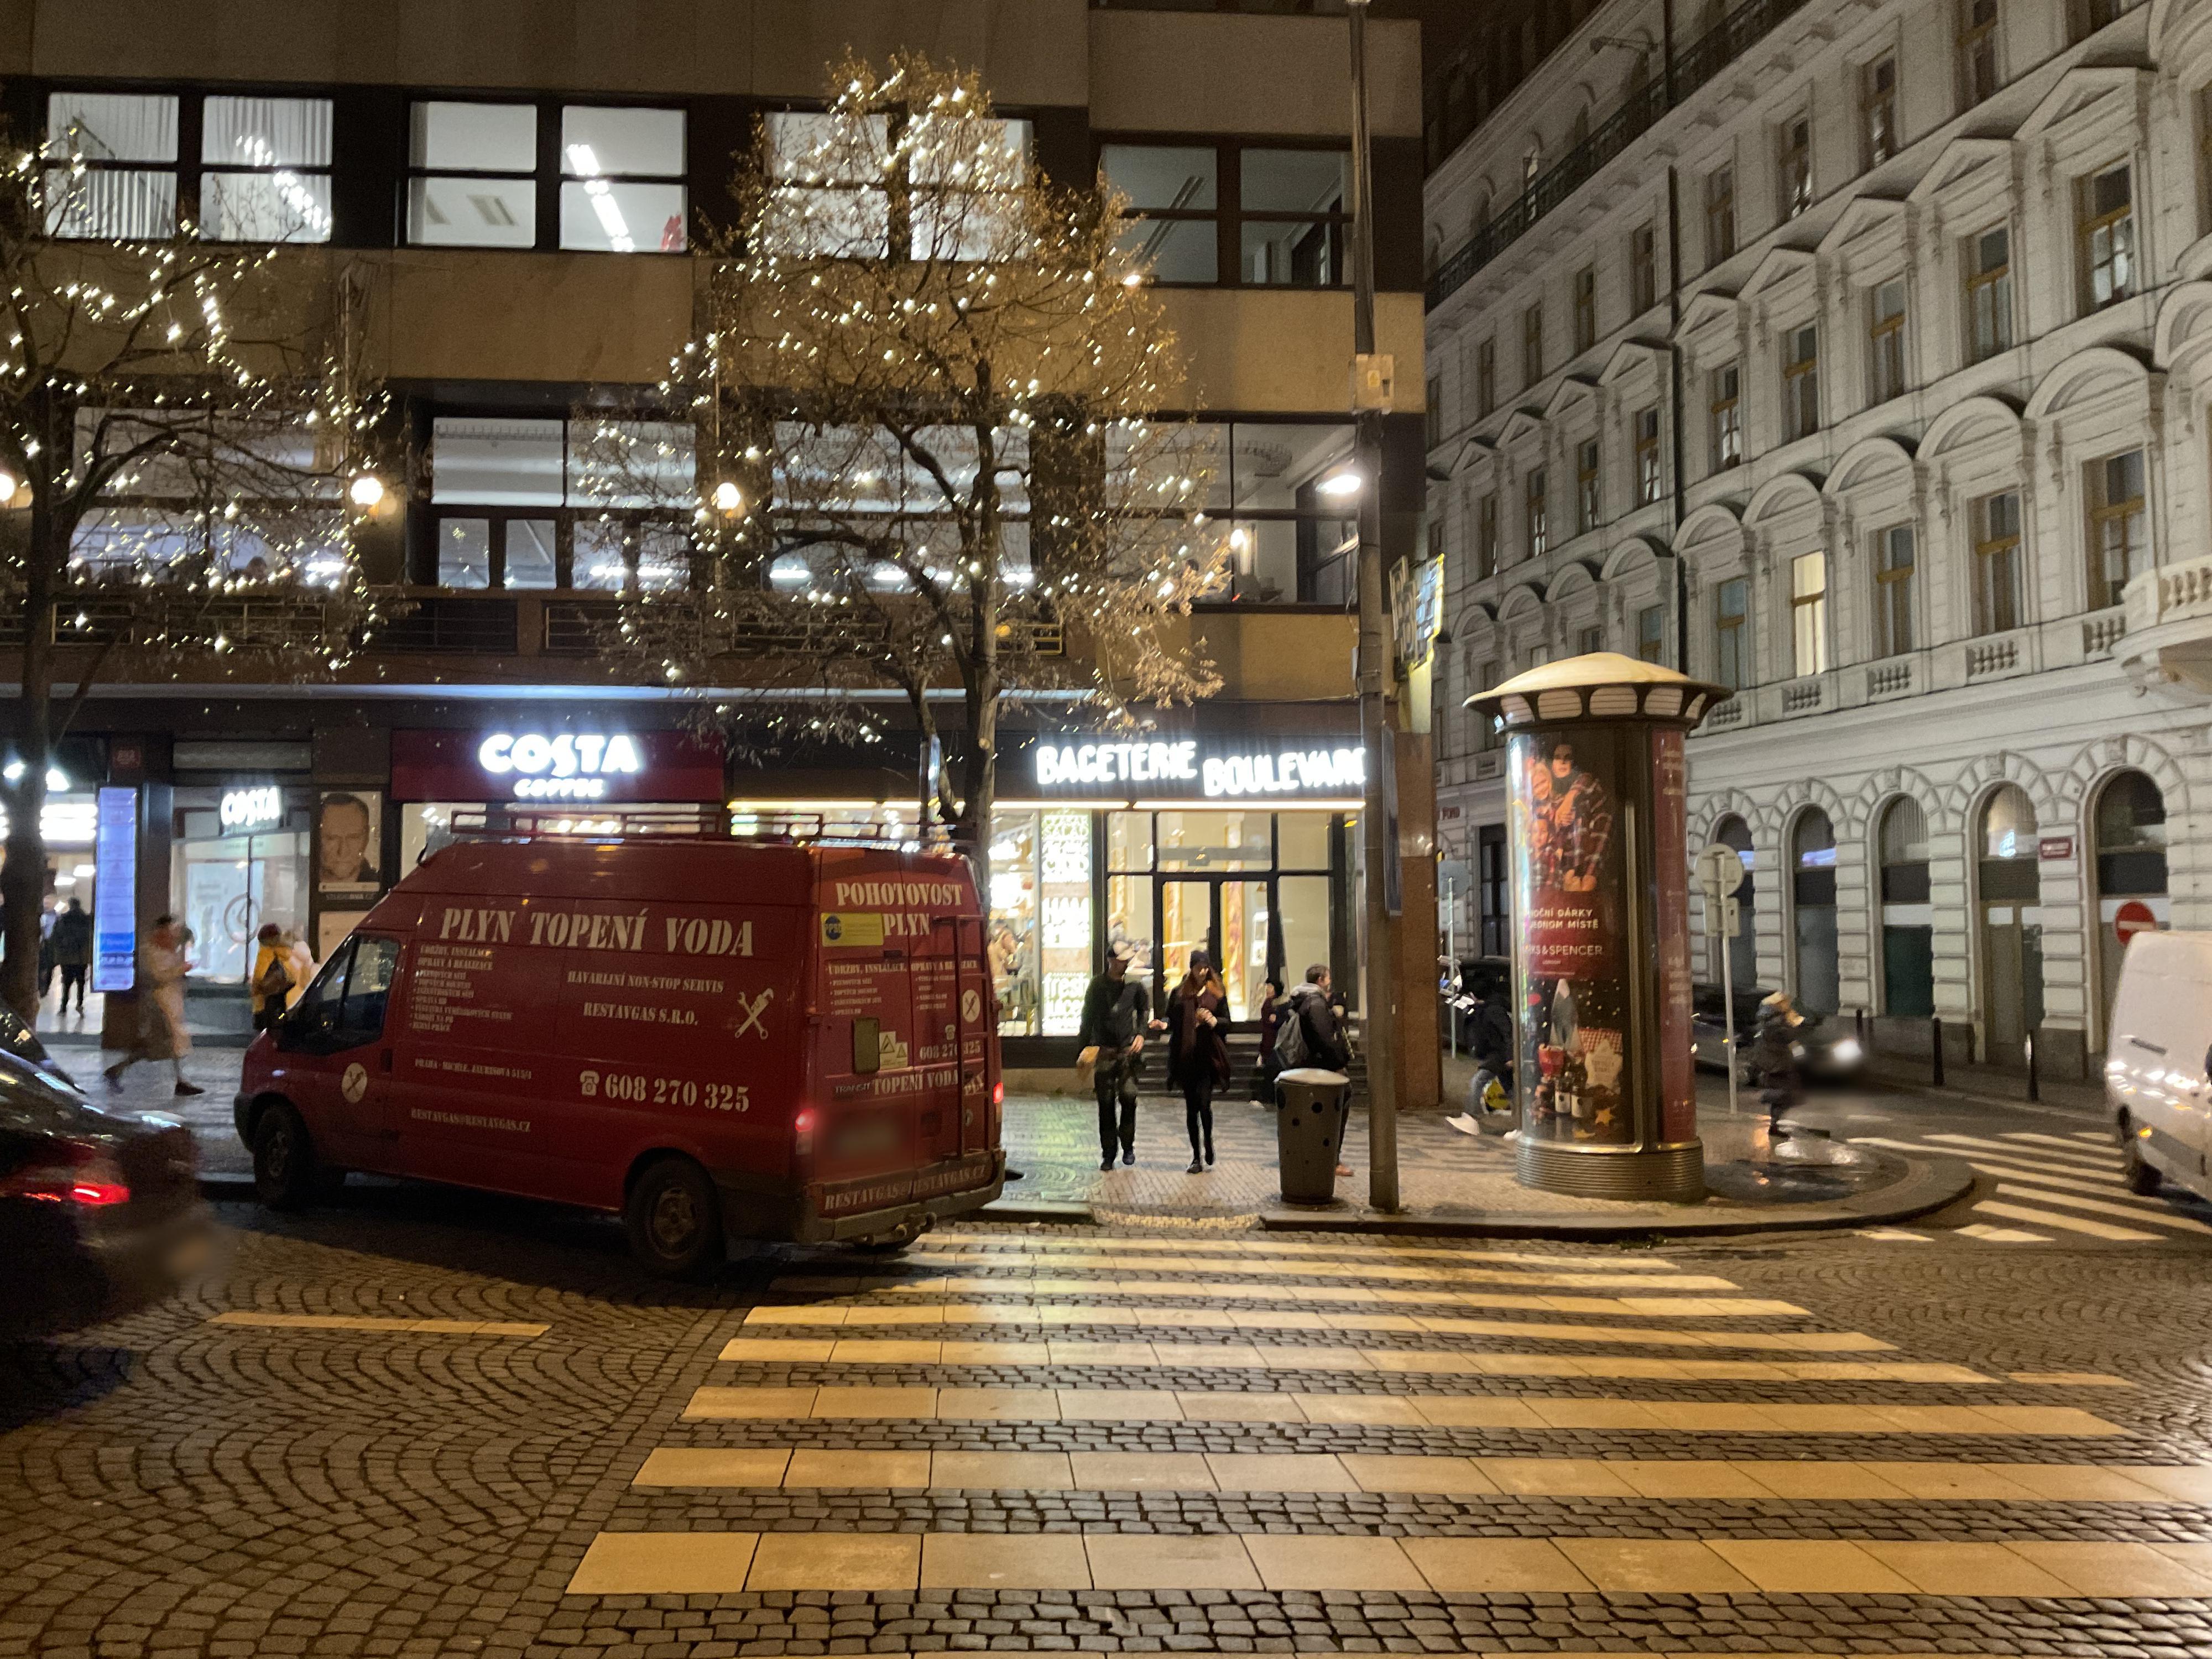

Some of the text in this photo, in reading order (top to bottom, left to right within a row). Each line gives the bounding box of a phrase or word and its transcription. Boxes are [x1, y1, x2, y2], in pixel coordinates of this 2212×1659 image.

[480, 734, 639, 778] COSTA
[1036, 741, 1197, 785] BAGETERIE
[514, 778, 604, 797] COFFEE
[835, 883, 962, 906] POHOTOVOST
[883, 912, 930, 936] PLYN
[1557, 907, 1593, 918] DÁRKY
[1568, 918, 1599, 930] MÍSTĚ
[439, 907, 753, 957] PLYN TOPENÍ VODA
[628, 975, 681, 990] NON-STOP
[682, 978, 724, 993] SERVIS
[583, 1001, 698, 1026] RESTAVGAS S.R.O.
[919, 1045, 940, 1060] 608
[604, 1073, 749, 1113] 608 270 325
[834, 1082, 870, 1094] TRANSIT
[873, 1069, 958, 1096] TOPENÍ VODA
